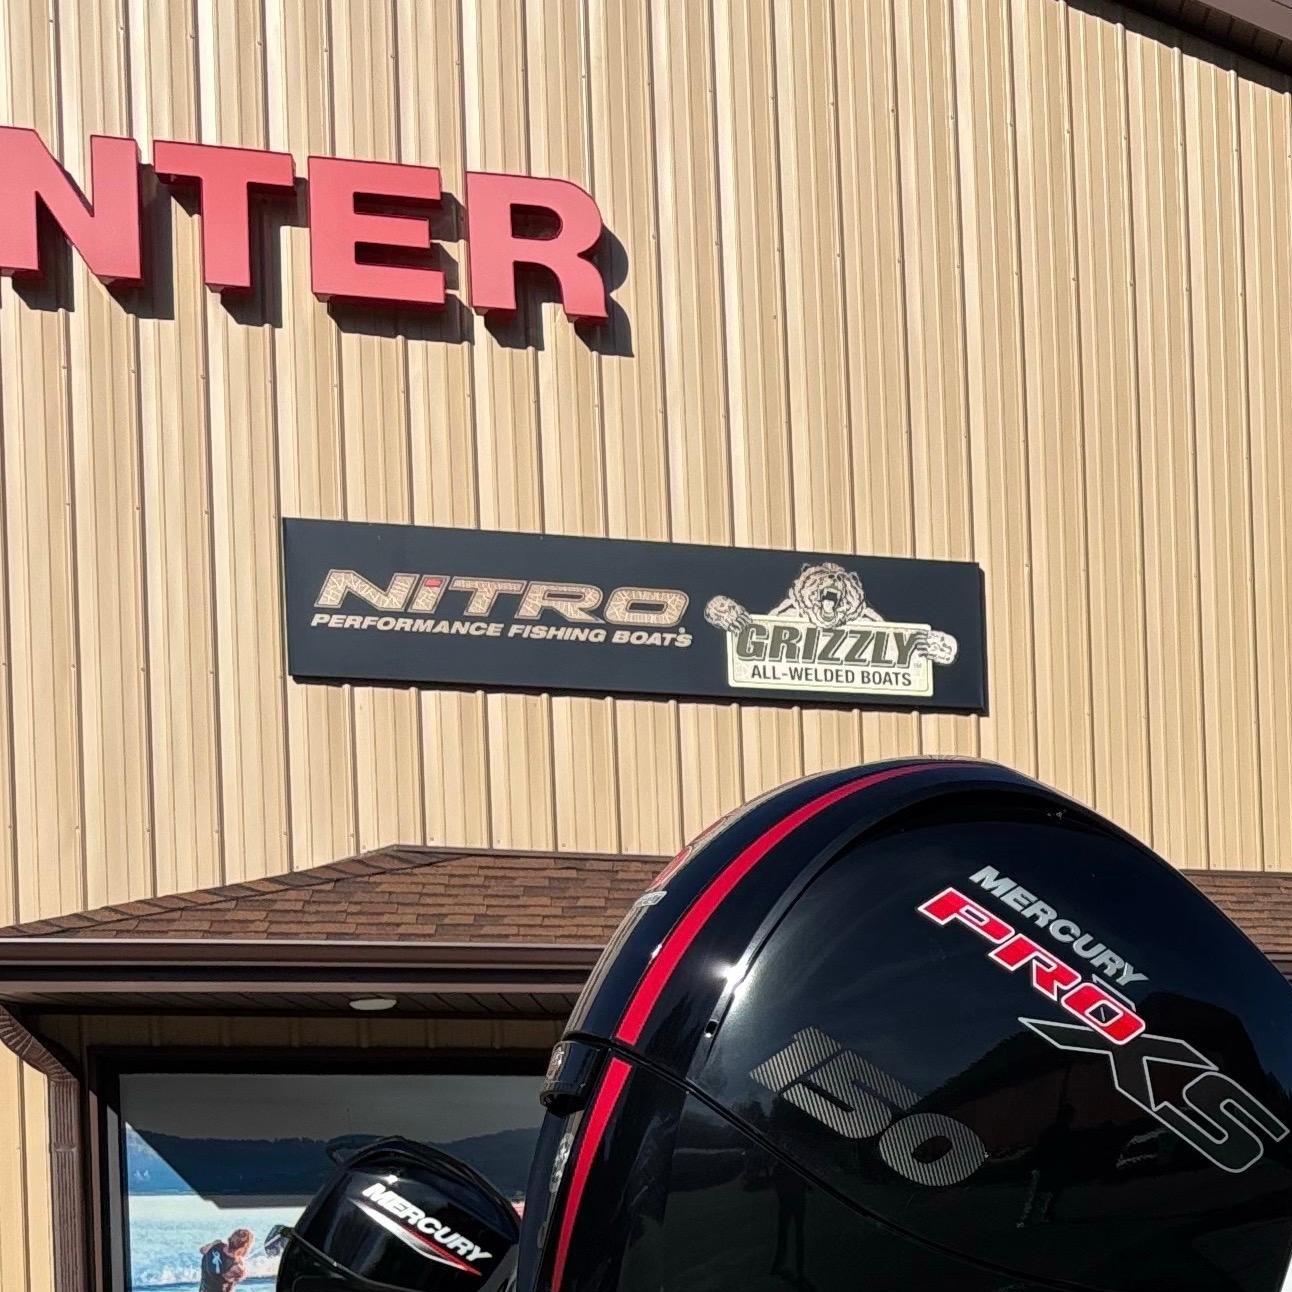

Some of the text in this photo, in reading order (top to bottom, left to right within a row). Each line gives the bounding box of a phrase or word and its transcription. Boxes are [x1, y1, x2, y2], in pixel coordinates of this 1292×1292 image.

[311, 613, 693, 648] PERFORMANCE FISHING BOATS
[735, 623, 917, 668] GRIZZLY
[751, 664, 912, 686] ALL-WELDED BOATS
[917, 887, 1147, 1046] PRO
[968, 865, 1150, 986] MERCURY
[749, 1027, 990, 1187] 150
[1017, 974, 1290, 1174] XS
[362, 1183, 492, 1261] MERCURY
